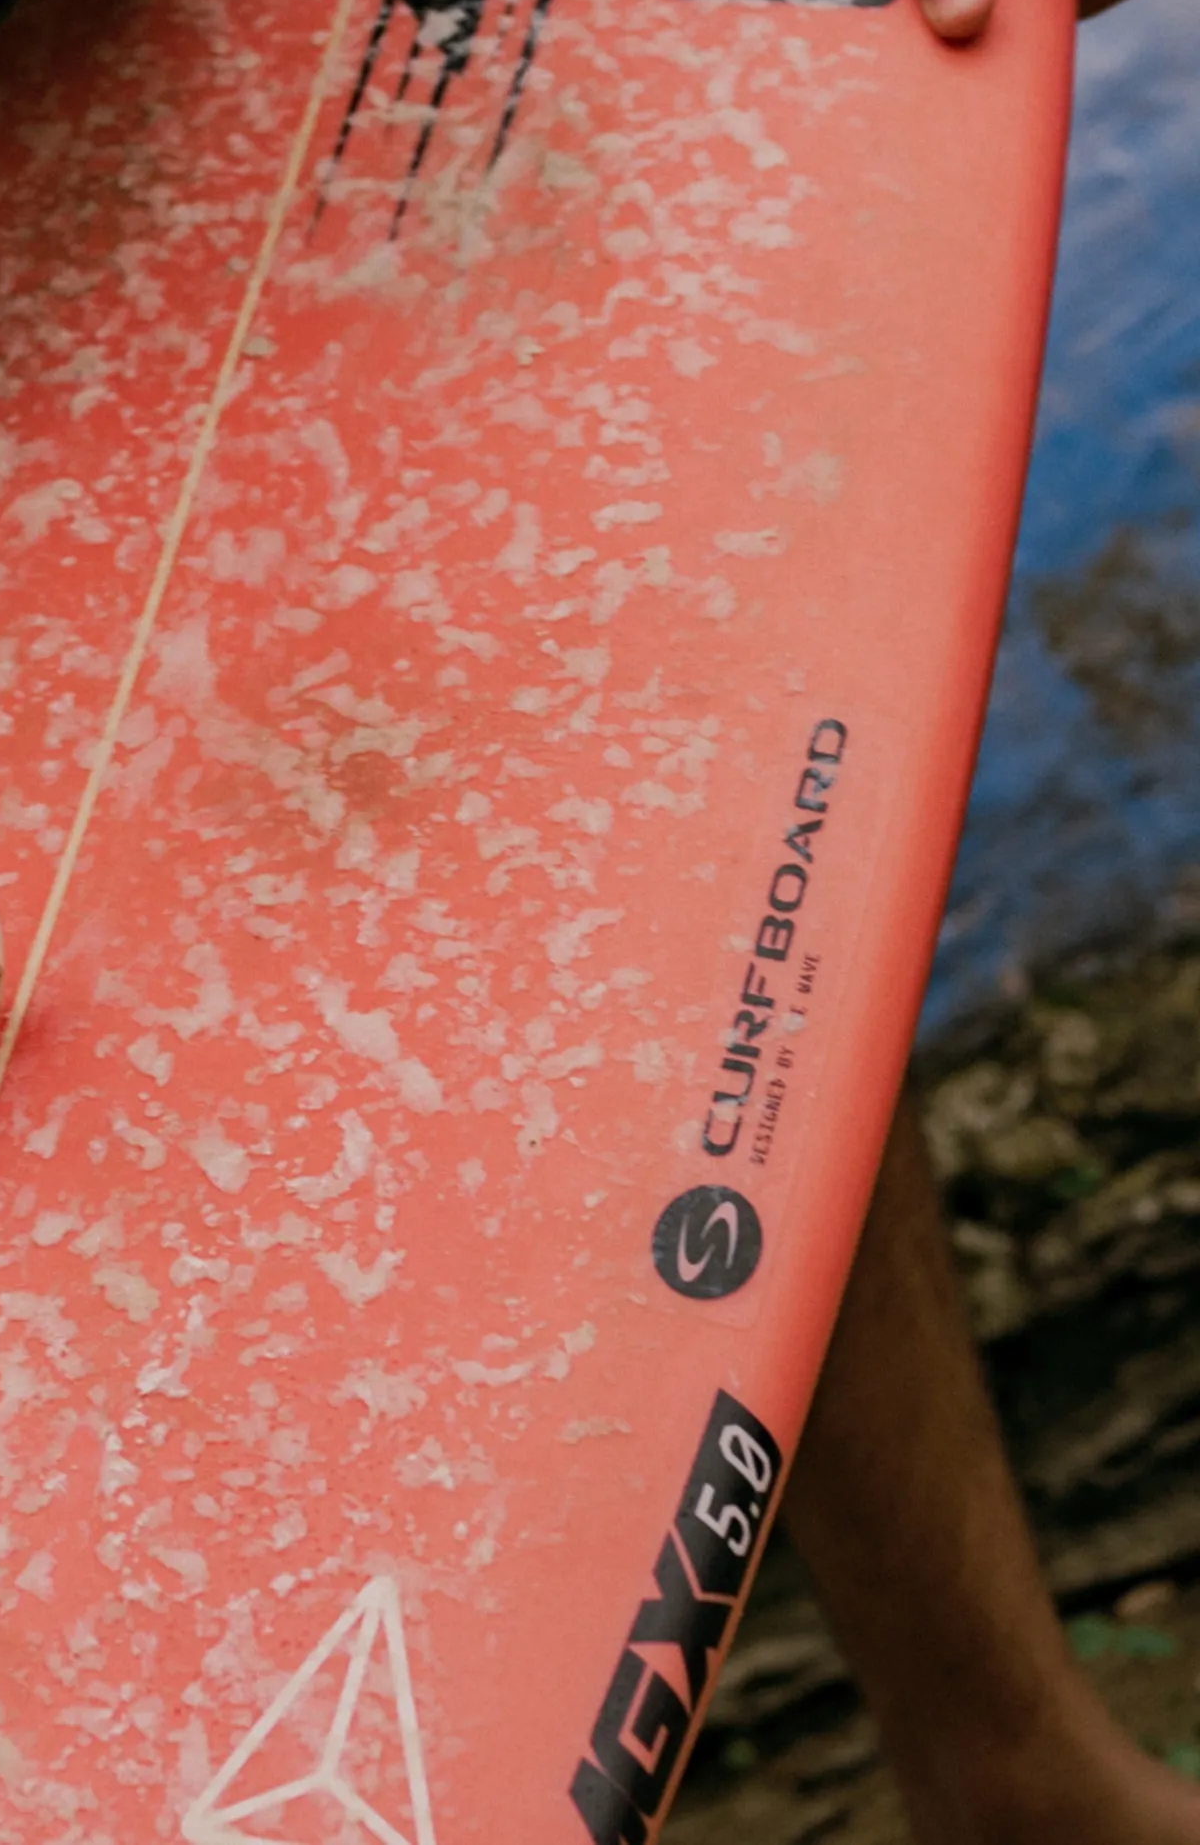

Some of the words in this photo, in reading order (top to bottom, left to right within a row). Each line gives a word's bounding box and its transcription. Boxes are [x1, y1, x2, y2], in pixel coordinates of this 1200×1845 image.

[700, 717, 849, 1158] CURFBOARD
[749, 1078, 787, 1166] DESIGNED
[776, 1045, 795, 1070] BY
